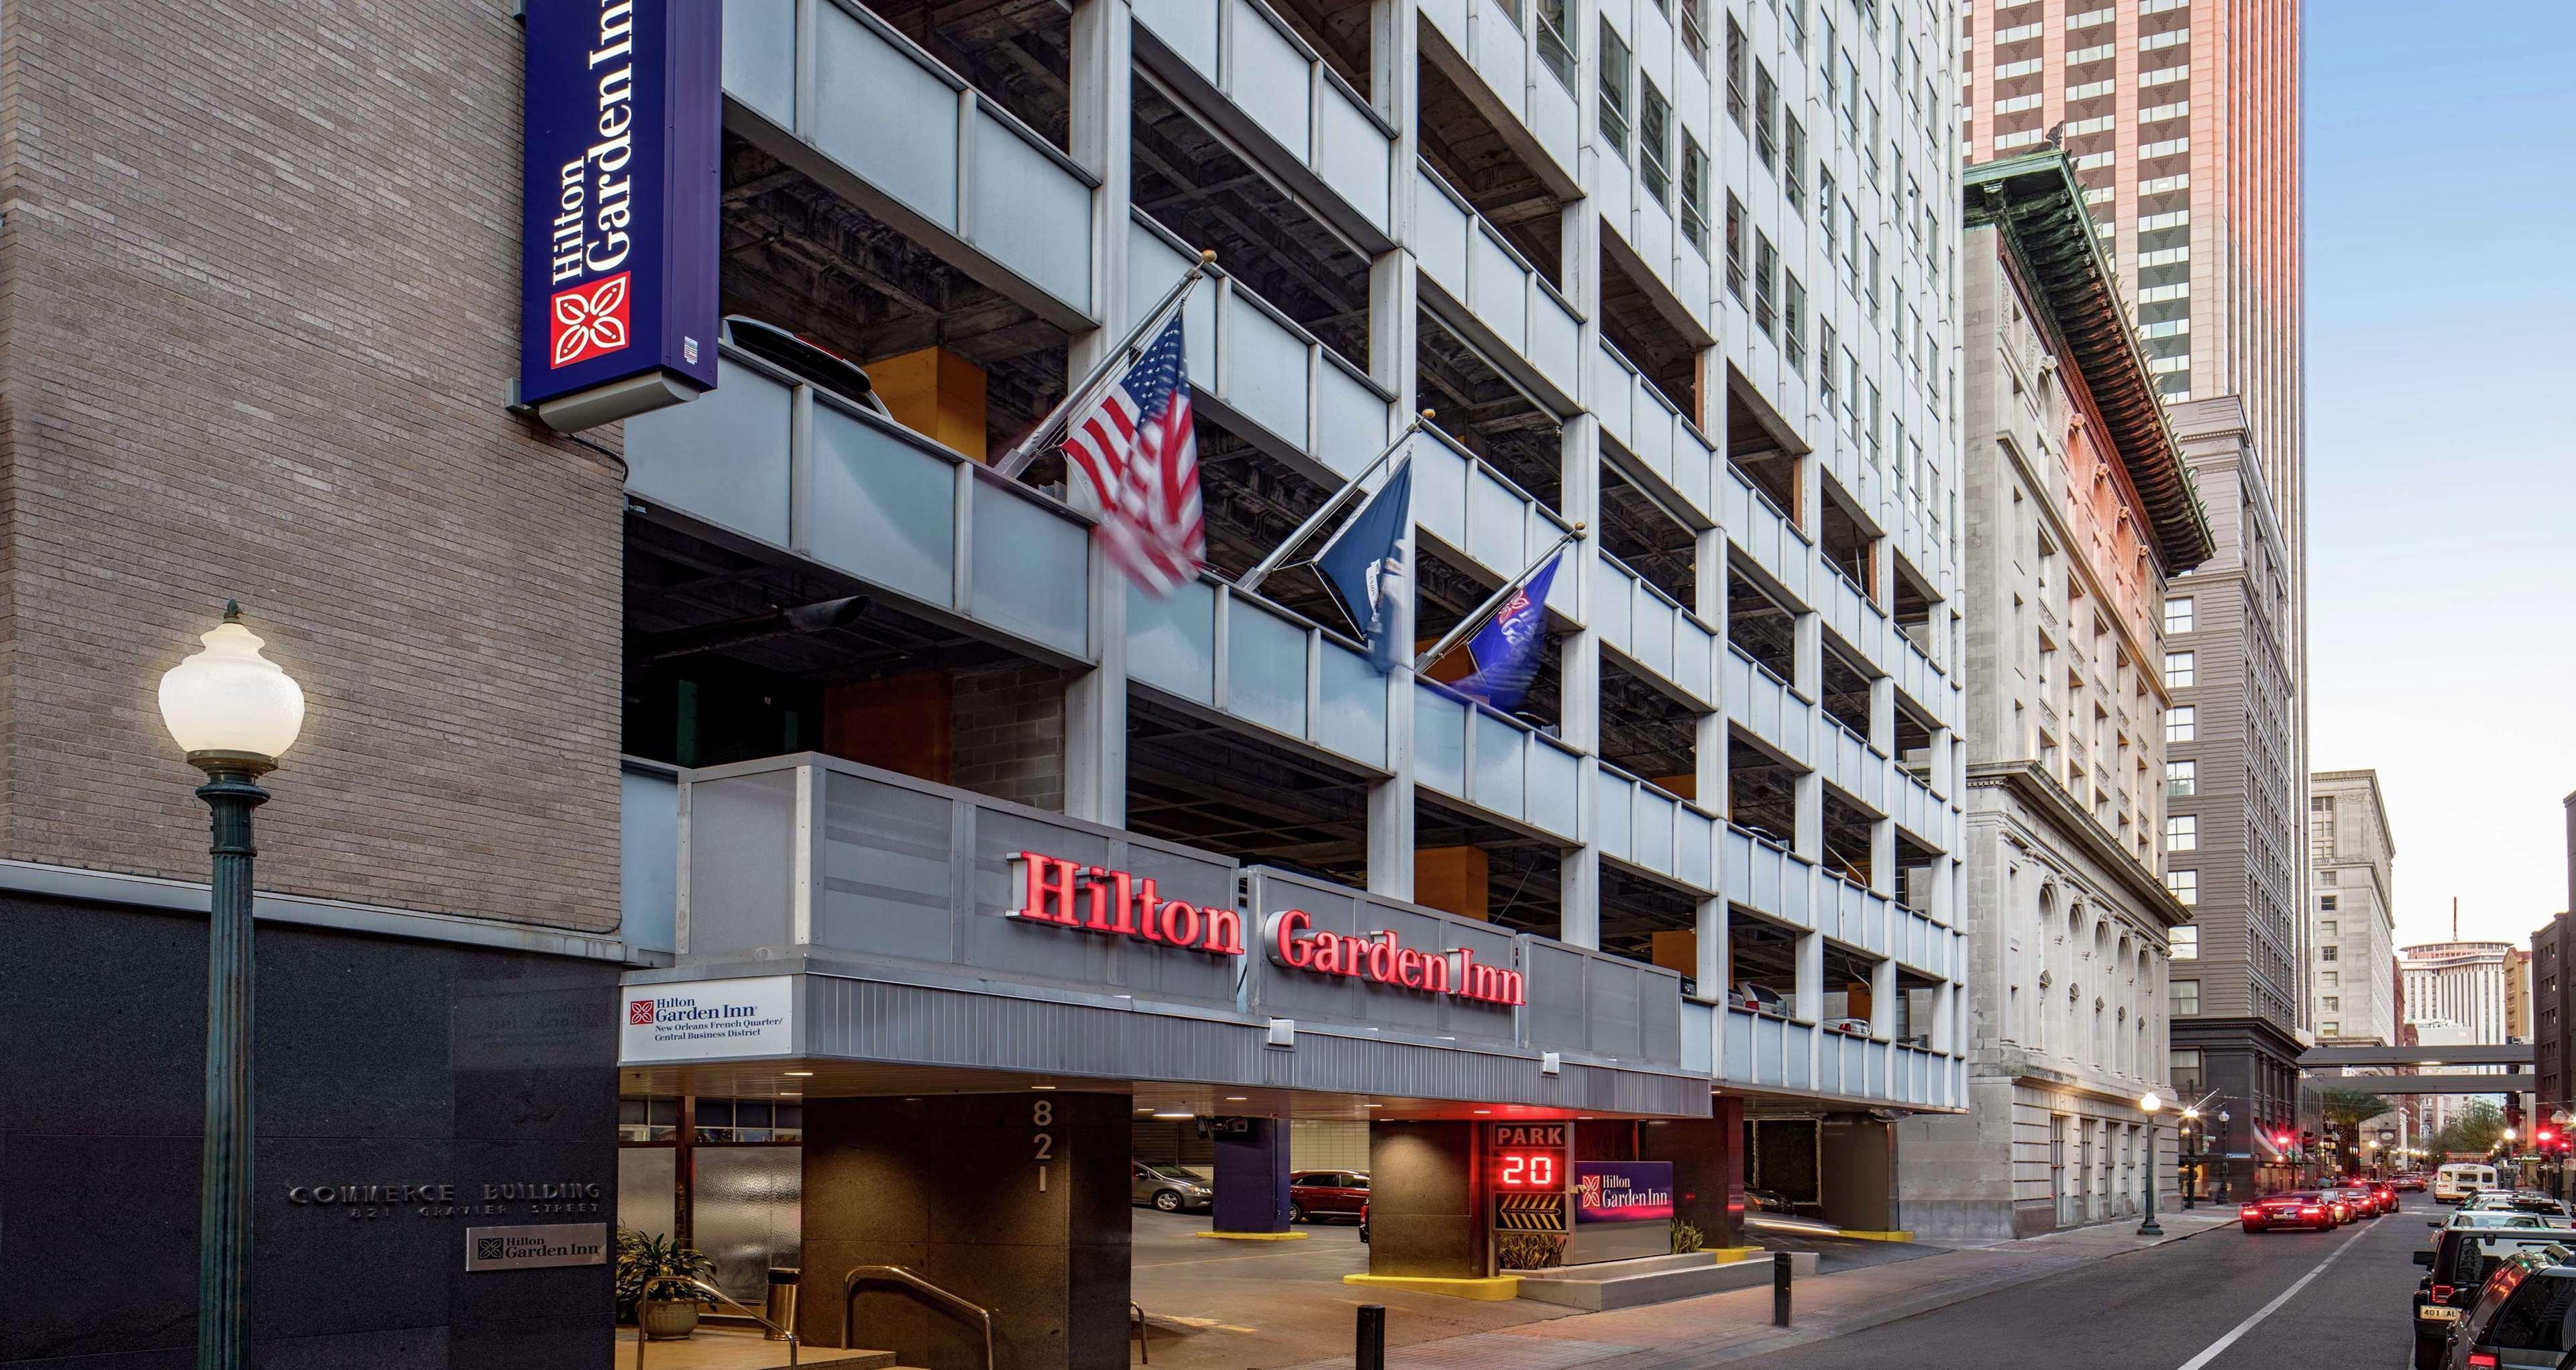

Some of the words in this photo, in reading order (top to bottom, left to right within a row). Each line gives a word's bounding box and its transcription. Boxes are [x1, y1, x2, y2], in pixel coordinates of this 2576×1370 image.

[589, 0, 633, 70] In
[586, 62, 632, 272] Garden
[552, 156, 586, 285] Hilton
[1006, 851, 1245, 955] Hilton
[1264, 909, 1451, 993] Garden
[1450, 947, 1526, 1006] Inn
[657, 998, 695, 1008] Hilton
[655, 1006, 719, 1023] Garden
[723, 1004, 755, 1018] Inn
[655, 1024, 673, 1033] New
[674, 1022, 708, 1031] Orleans
[710, 1020, 742, 1029] French
[743, 1018, 783, 1028] Quarter/
[655, 1033, 686, 1041] Central
[688, 1031, 726, 1040] Business
[728, 1029, 761, 1038] District
[1034, 1100, 1052, 1191] 821
[1498, 1128, 1564, 1145] PARK
[1503, 1156, 1552, 1184] 20
[1603, 1175, 1630, 1188] Hilton
[290, 1184, 454, 1205] COMMERCE
[484, 1183, 600, 1200] BUILDING
[1603, 1189, 1646, 1208] Garden
[1648, 1189, 1668, 1206] Inn
[350, 1208, 390, 1219] 821
[419, 1206, 507, 1217] GRAVIER
[531, 1203, 599, 1214] STREET
[505, 1245, 568, 1259] Garden
[570, 1243, 599, 1255] Inn
[506, 1237, 545, 1246] Hilton
